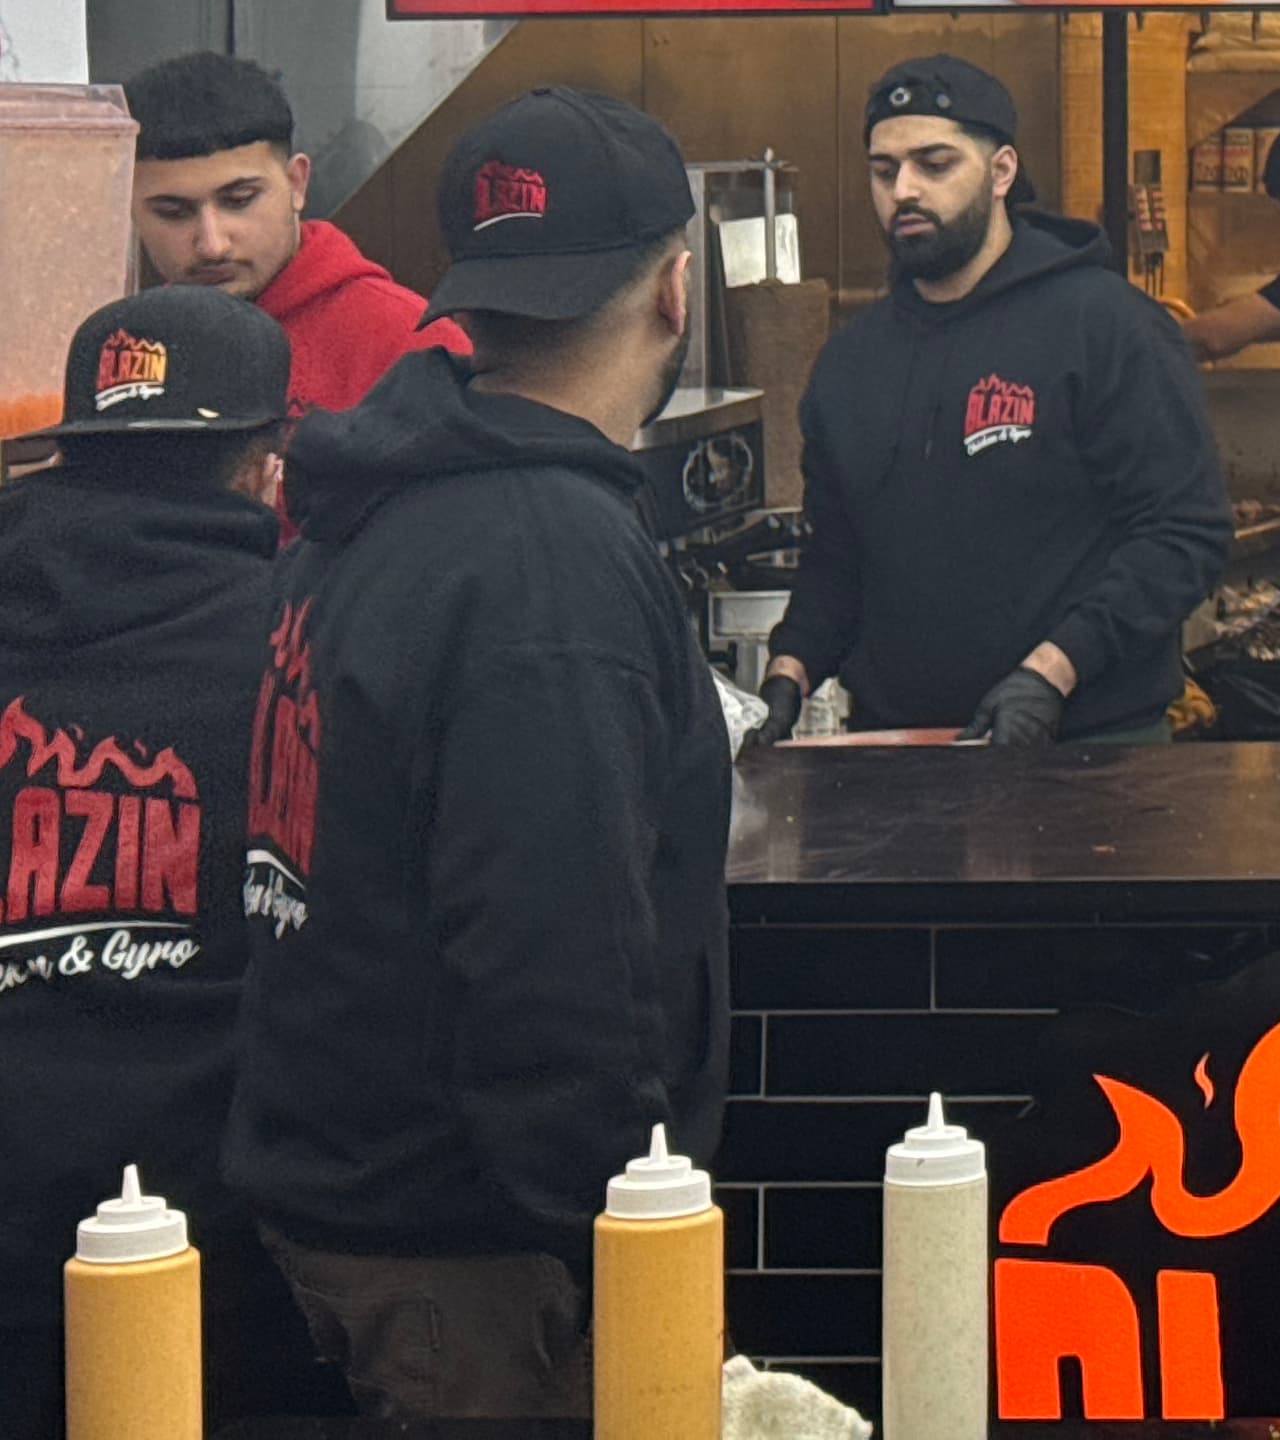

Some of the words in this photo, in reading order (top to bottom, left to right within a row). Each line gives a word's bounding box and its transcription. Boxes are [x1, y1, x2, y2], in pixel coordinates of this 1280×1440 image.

[964, 392, 1036, 436] BLAZIN
[59, 934, 95, 977] &
[101, 928, 201, 980] Gyro
